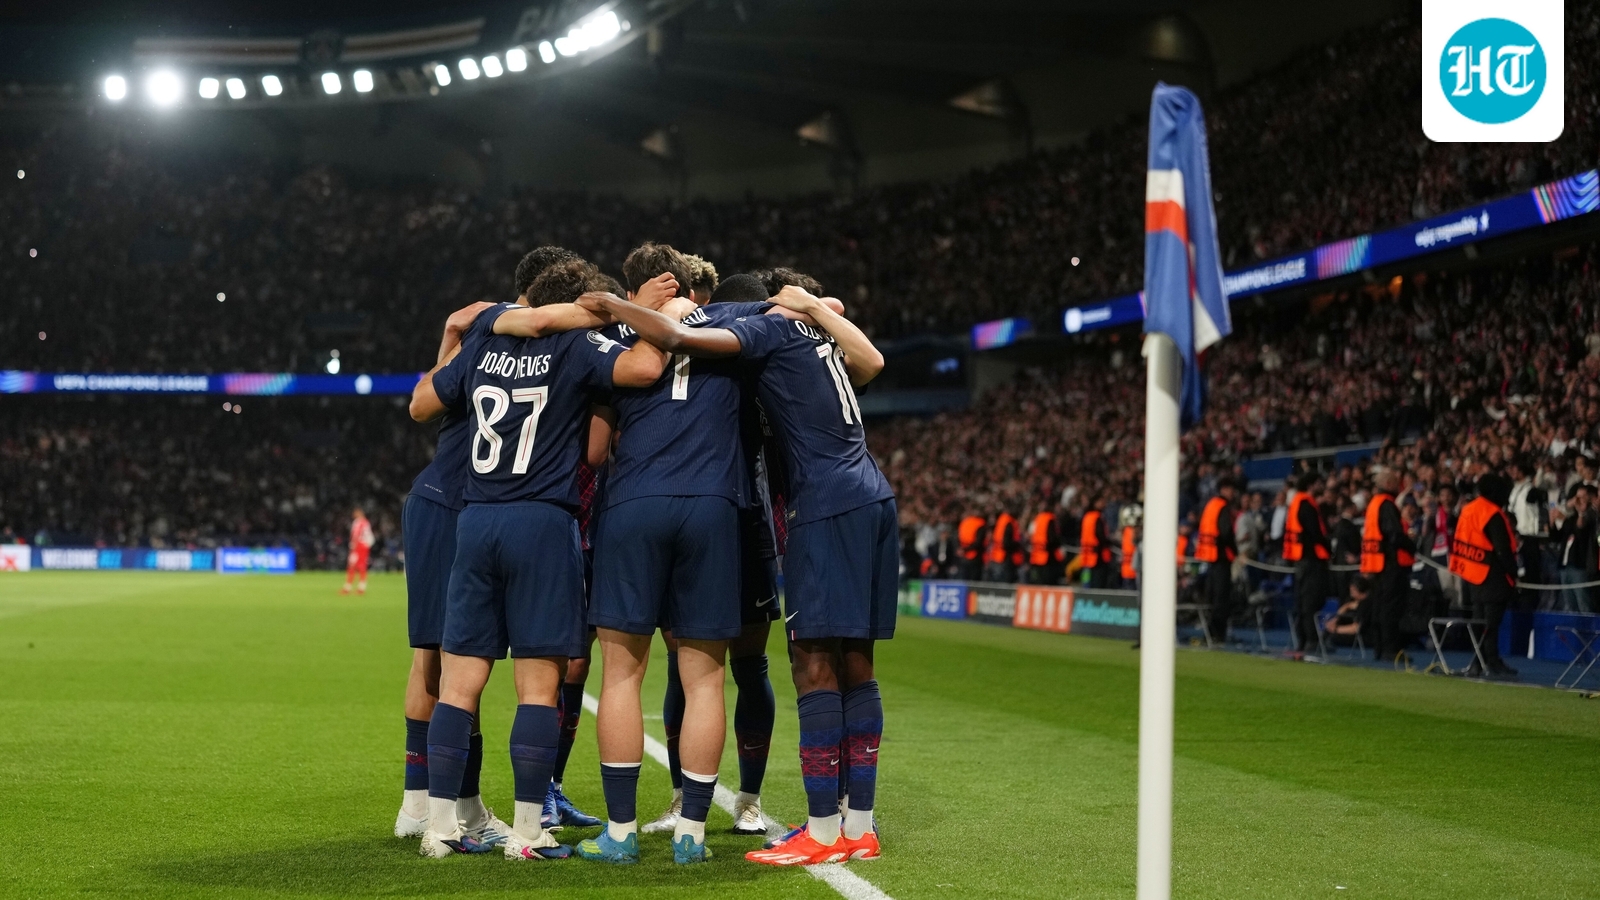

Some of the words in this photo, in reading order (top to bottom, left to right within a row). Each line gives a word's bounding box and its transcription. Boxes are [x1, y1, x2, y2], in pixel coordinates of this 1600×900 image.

[477, 351, 516, 378] JOÃO
[87, 374, 160, 391] CHAMPIONS
[160, 375, 208, 391] LEAGUE
[472, 385, 549, 474] 87
